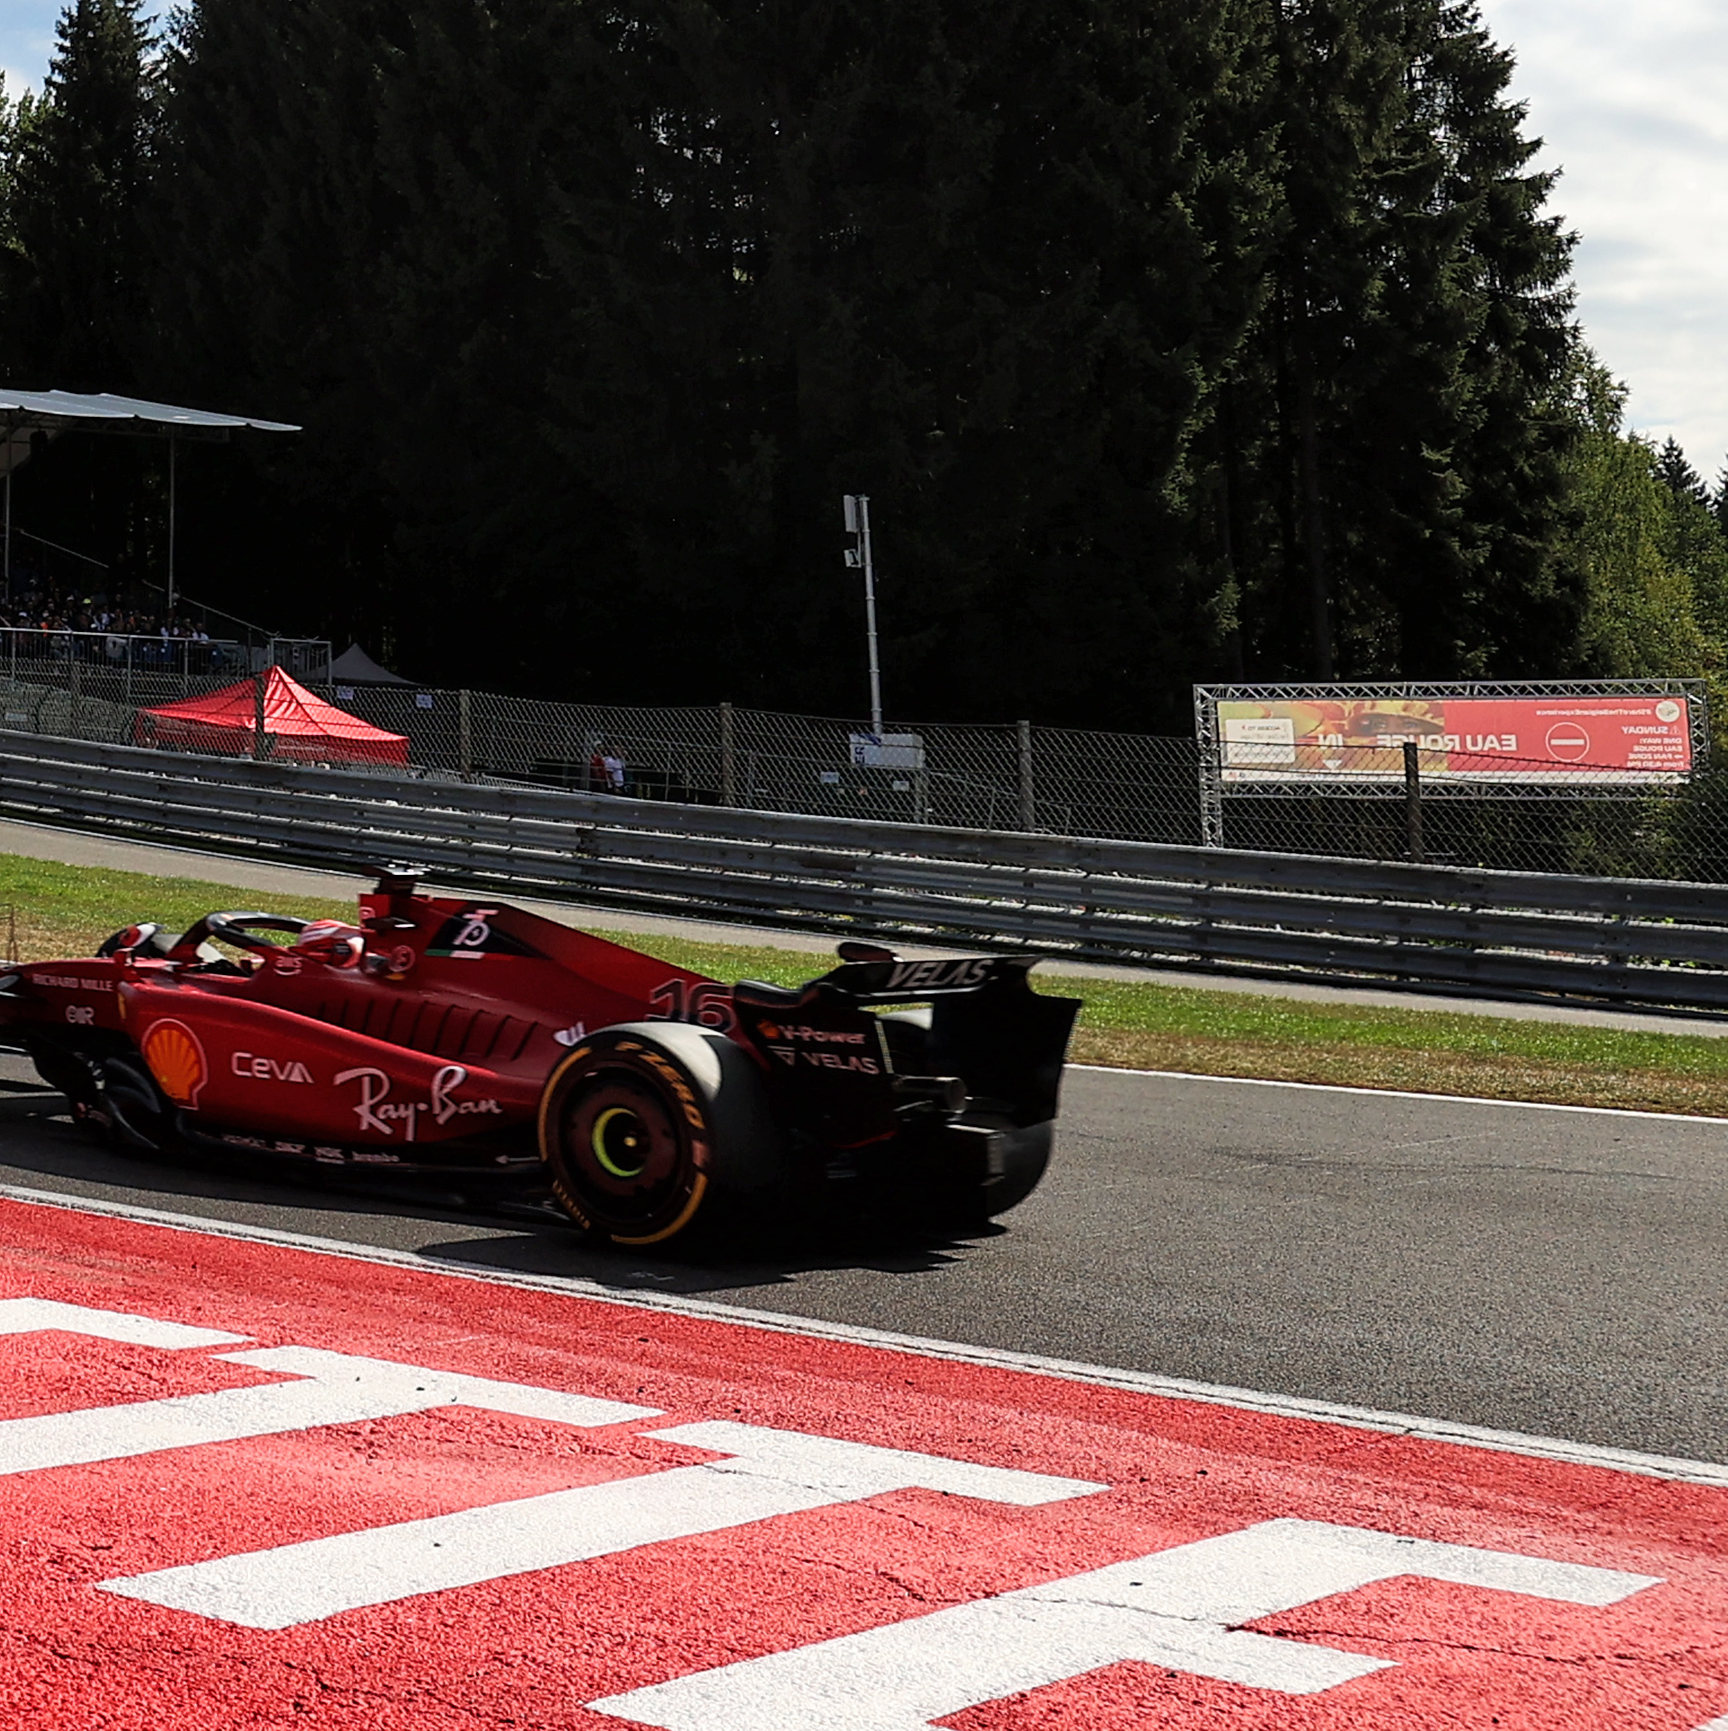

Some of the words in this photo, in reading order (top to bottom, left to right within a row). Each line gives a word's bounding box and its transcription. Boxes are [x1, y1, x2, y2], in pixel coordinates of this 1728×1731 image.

[885, 958, 995, 988] VELAS
[644, 977, 737, 1035] 16
[777, 1025, 867, 1045] V-Power
[800, 1051, 880, 1075] VELAS
